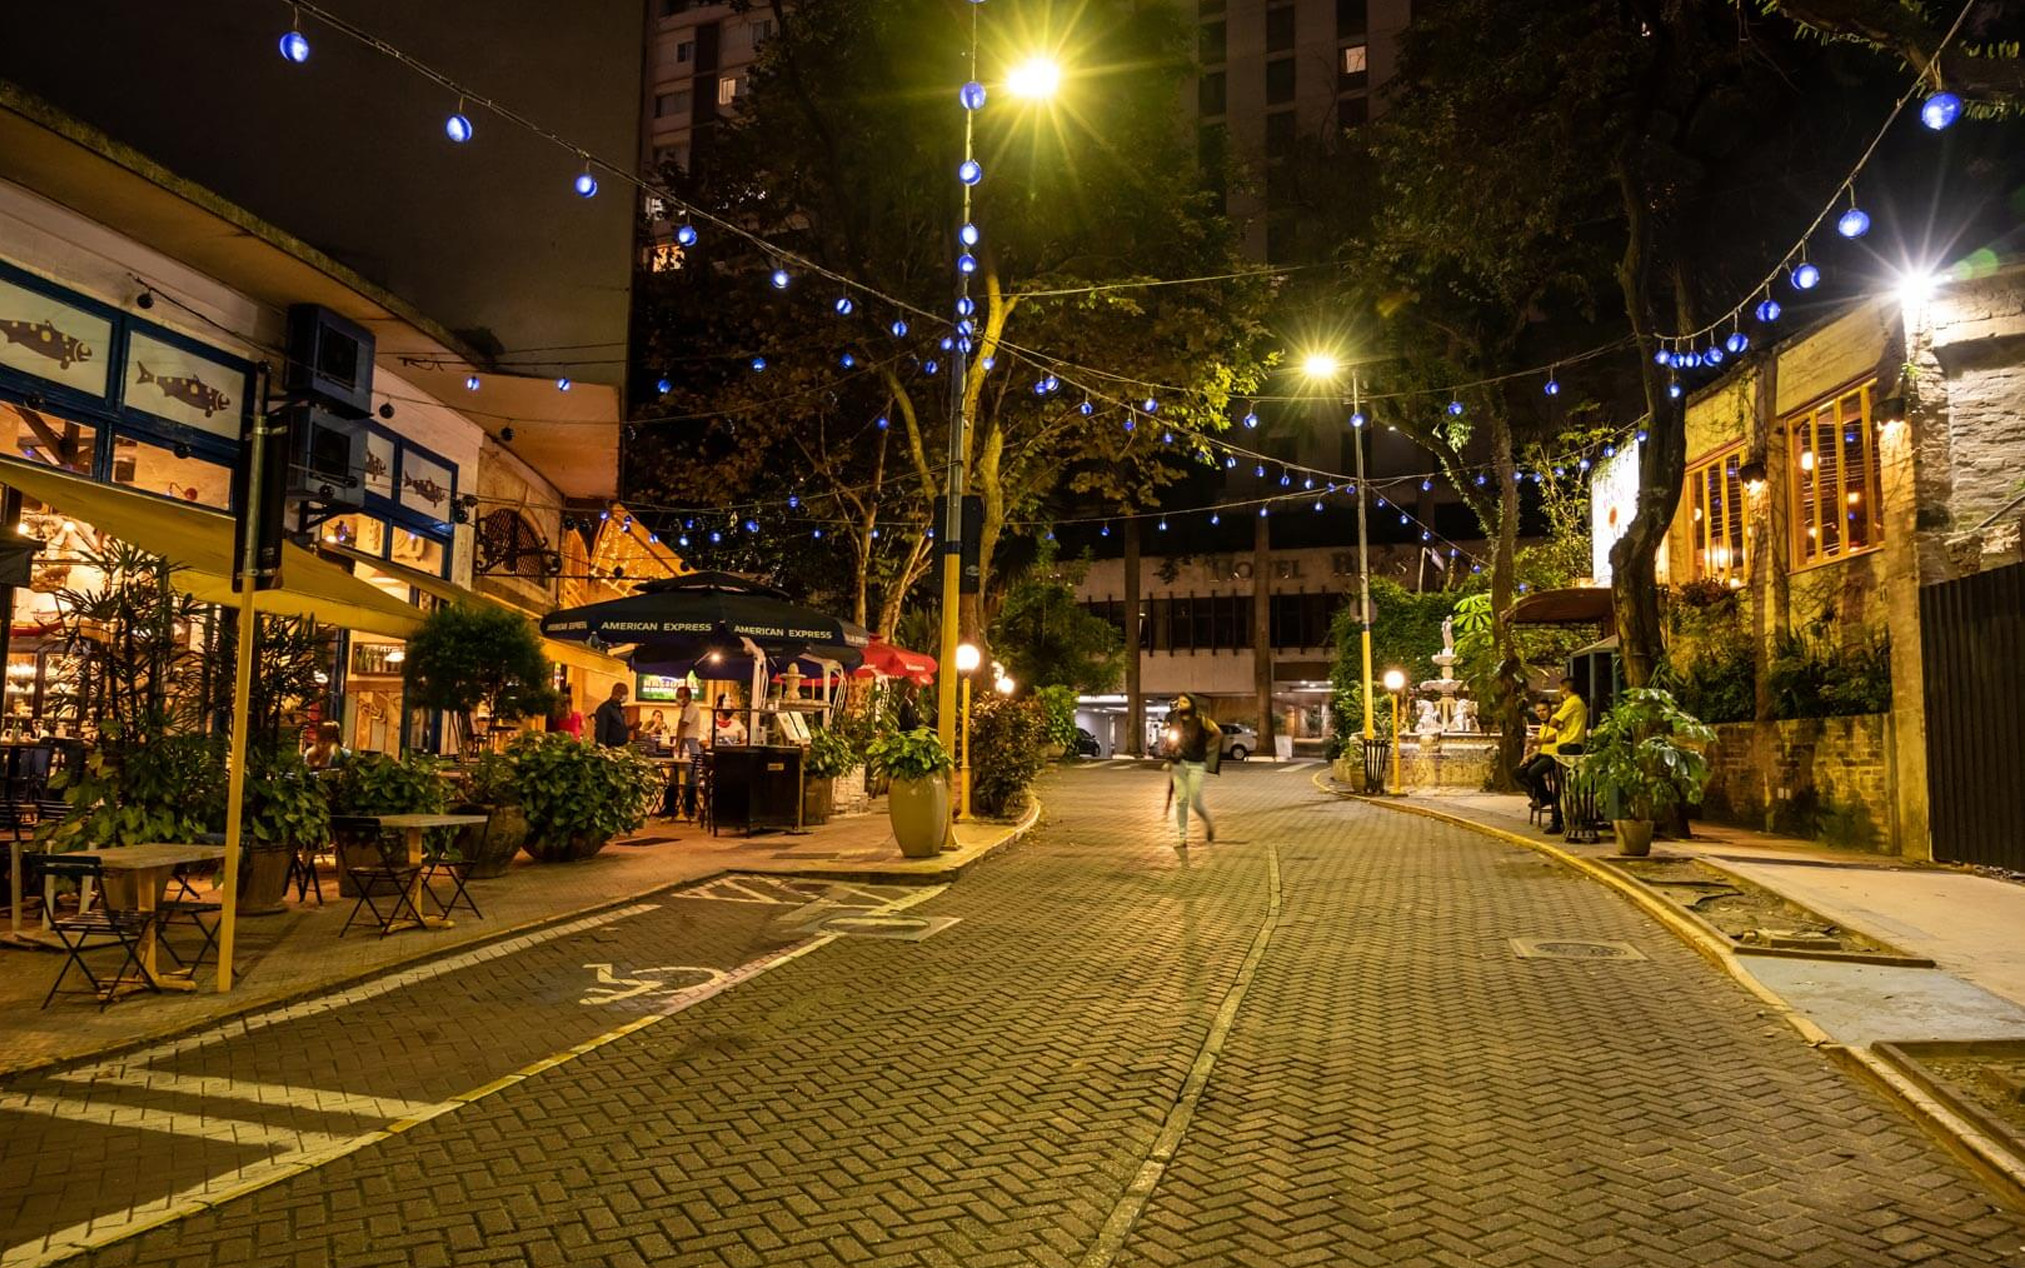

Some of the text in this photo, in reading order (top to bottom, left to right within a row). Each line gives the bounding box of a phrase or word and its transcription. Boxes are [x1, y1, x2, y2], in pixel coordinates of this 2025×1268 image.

[1208, 558, 1307, 582] HOEL
[601, 621, 712, 632] AMERICAN EXPRESS
[734, 624, 784, 637] AMERICAN
[788, 629, 833, 640] EXPRESS
